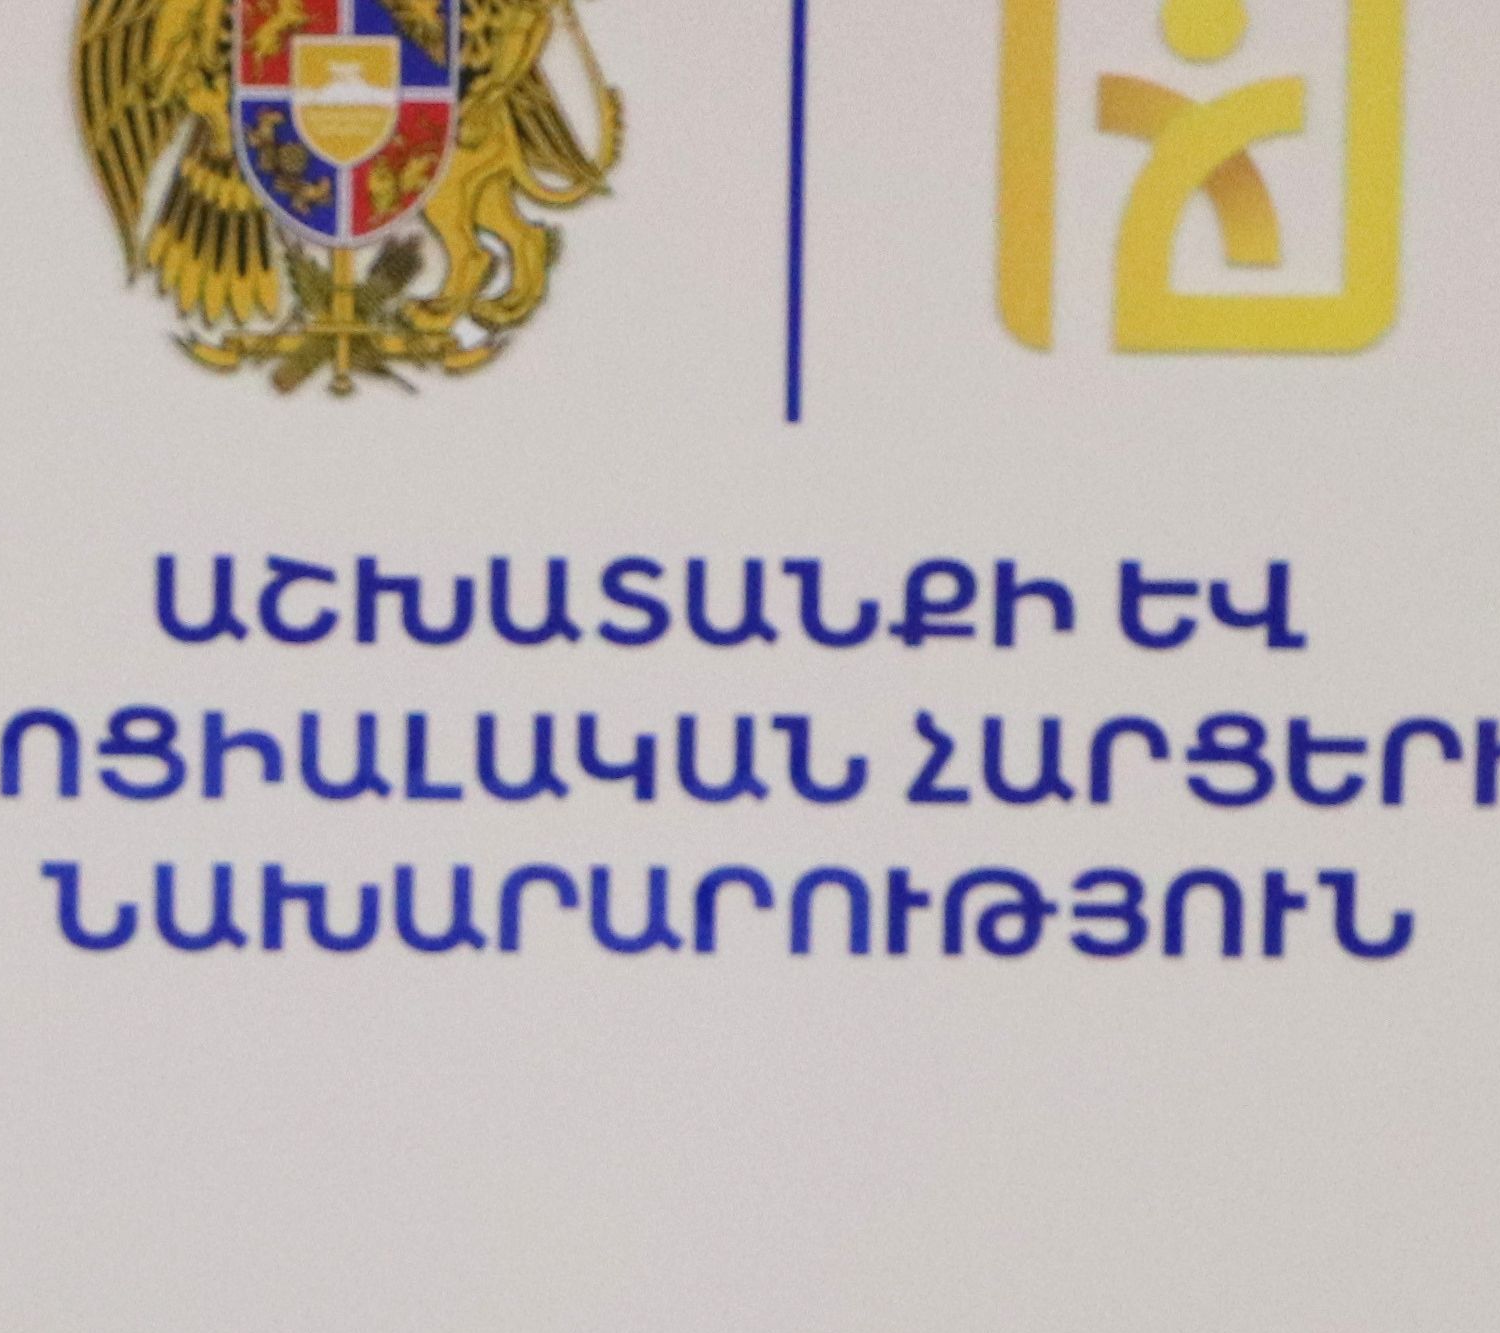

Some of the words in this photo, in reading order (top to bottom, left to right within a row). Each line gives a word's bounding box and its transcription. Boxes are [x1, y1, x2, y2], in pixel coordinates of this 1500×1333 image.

[153, 553, 1076, 650] ԱՇԽԱՏԱՆՔԻ
[1117, 558, 1308, 652] ԵՎ
[39, 859, 1416, 961] ՆԱԽԱՐԱՐՈՒԹՅՈՒՆ
